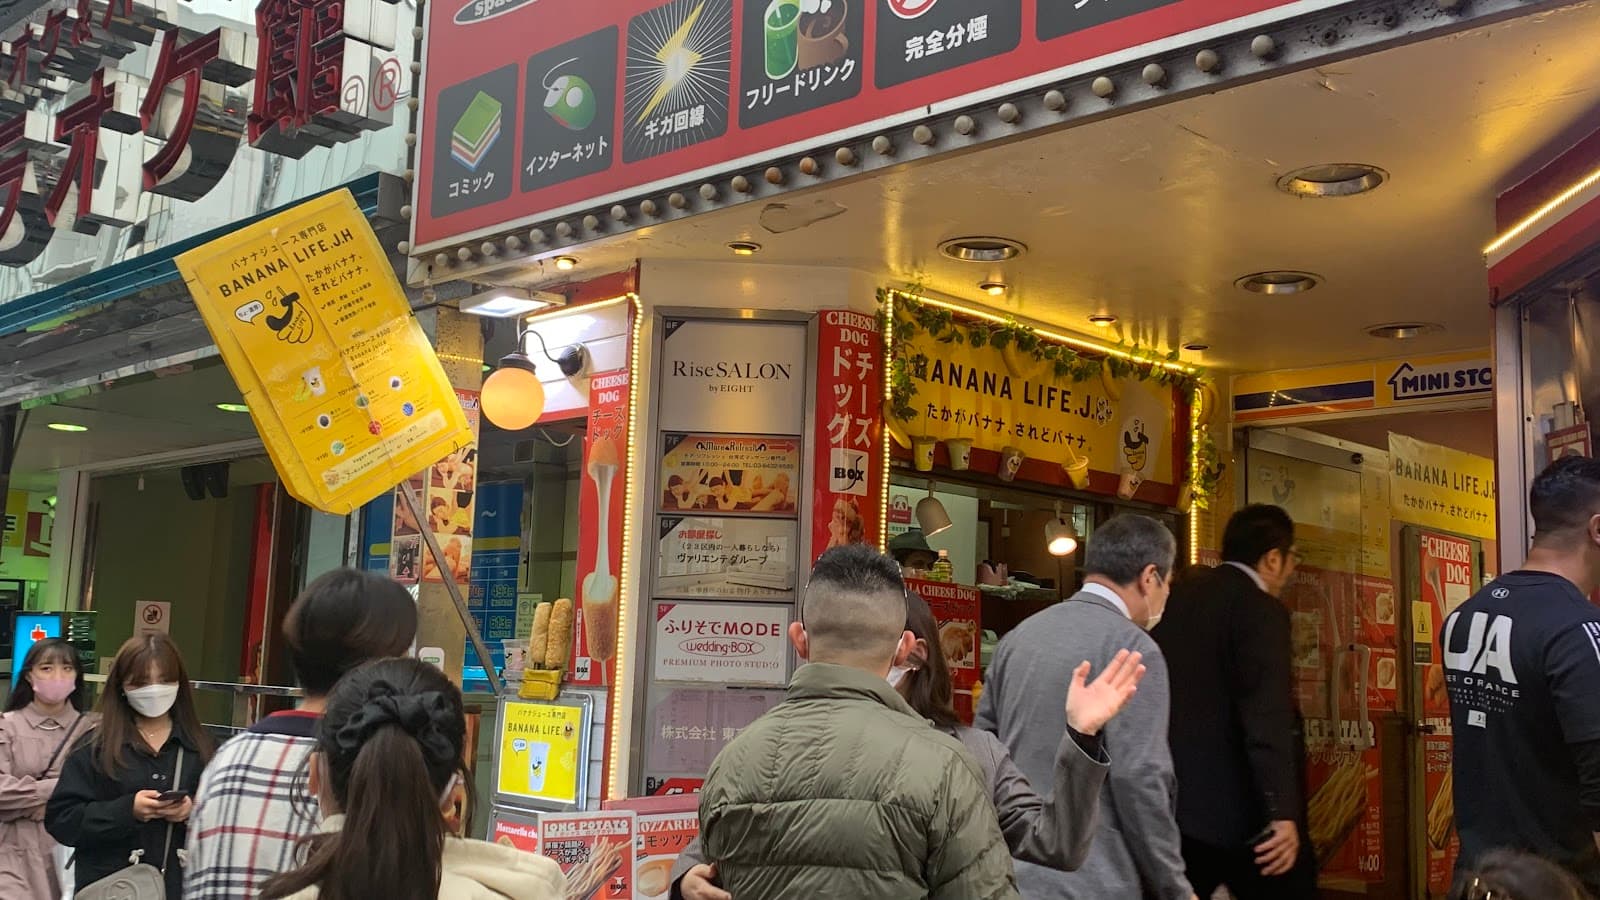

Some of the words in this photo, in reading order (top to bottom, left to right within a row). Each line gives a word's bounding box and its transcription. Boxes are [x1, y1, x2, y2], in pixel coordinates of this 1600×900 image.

[905, 14, 989, 63] 完全分煙
[745, 58, 857, 110] フリードリンク
[644, 104, 706, 141] ギガ回線
[525, 135, 609, 177] インターネット
[448, 171, 495, 199] コミック
[230, 221, 328, 272] バナナジュース専門店
[218, 257, 289, 298] BANANA
[293, 228, 354, 264] LIFE.J.H
[826, 311, 879, 333] CHEESE
[840, 328, 869, 347] DOG
[672, 360, 792, 380] RiseSALON
[591, 374, 629, 391] CHEESE
[709, 383, 719, 393] by
[720, 384, 755, 393] EIGHT
[1401, 371, 1450, 394] MINI
[598, 391, 620, 404] DOG
[827, 346, 853, 444] ドッグ
[854, 351, 874, 449] チーズ
[592, 424, 624, 442] ドッグ
[834, 467, 864, 481] BOX
[1395, 457, 1448, 488] BANANA
[662, 519, 675, 528] 6F
[1427, 537, 1471, 564] CHEESE
[1445, 562, 1471, 585] DOG
[921, 584, 958, 599] CHEESE
[957, 588, 976, 601] DOG
[664, 619, 781, 637] ふりそでMODE
[663, 658, 707, 667] PREMIUM
[710, 660, 741, 668] PHOTO
[744, 661, 779, 669] STUDIO
[507, 722, 539, 734] BANANA
[661, 724, 717, 742] 株式会社
[544, 822, 576, 833] LONG
[580, 820, 629, 831] POTATO
